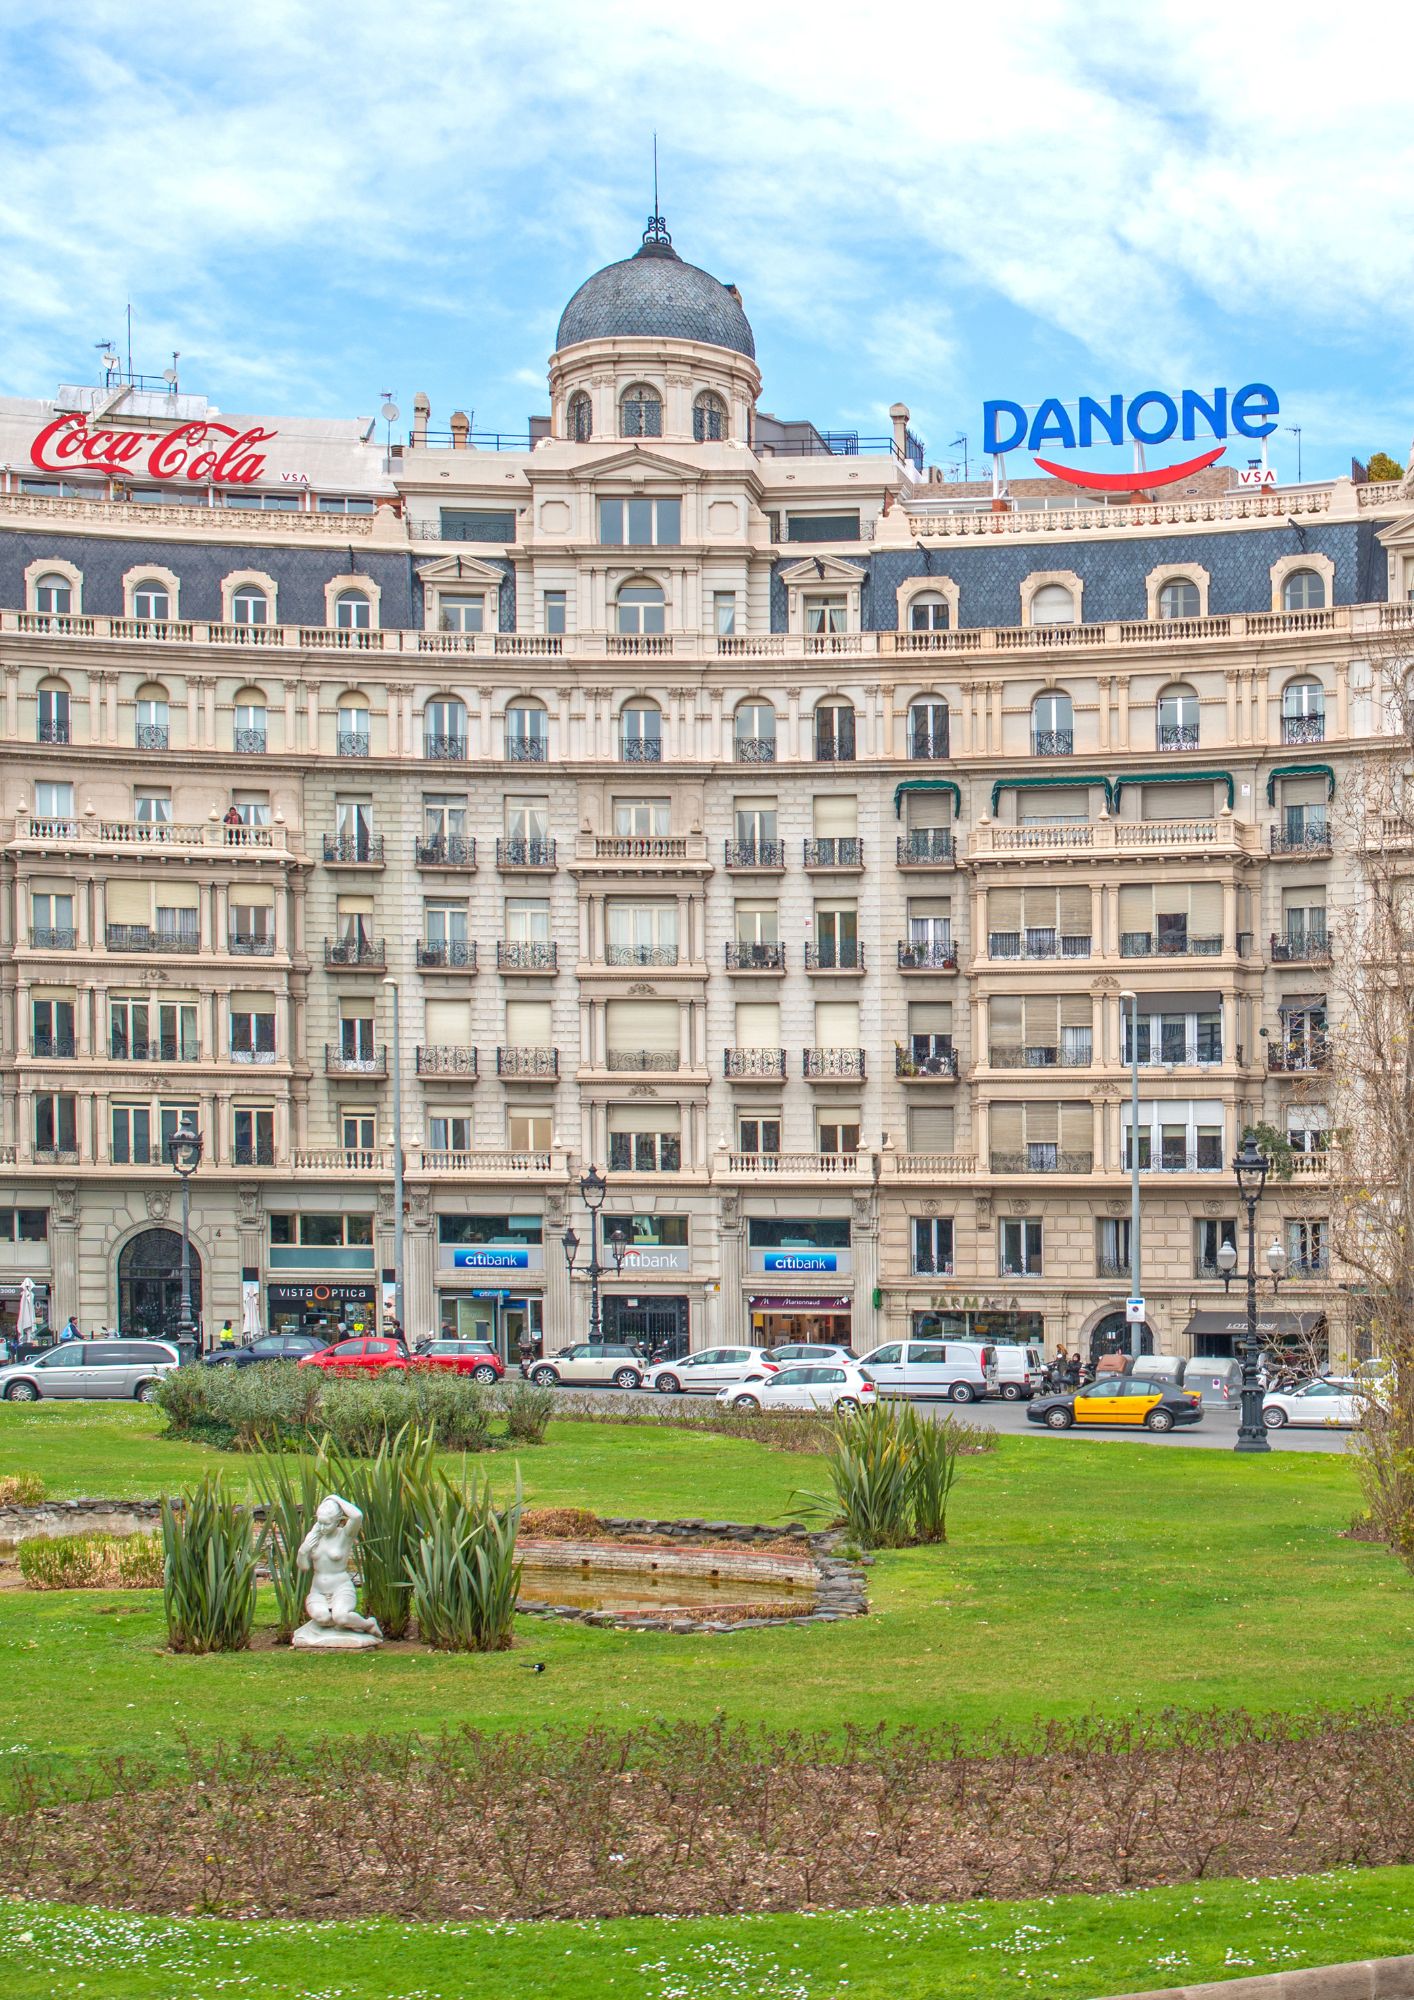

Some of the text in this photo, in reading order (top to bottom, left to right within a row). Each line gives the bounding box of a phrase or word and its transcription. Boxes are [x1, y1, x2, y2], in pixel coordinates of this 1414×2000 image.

[215, 1228, 222, 1238] 4
[465, 1251, 517, 1266] citibank
[775, 1255, 826, 1269] citibank
